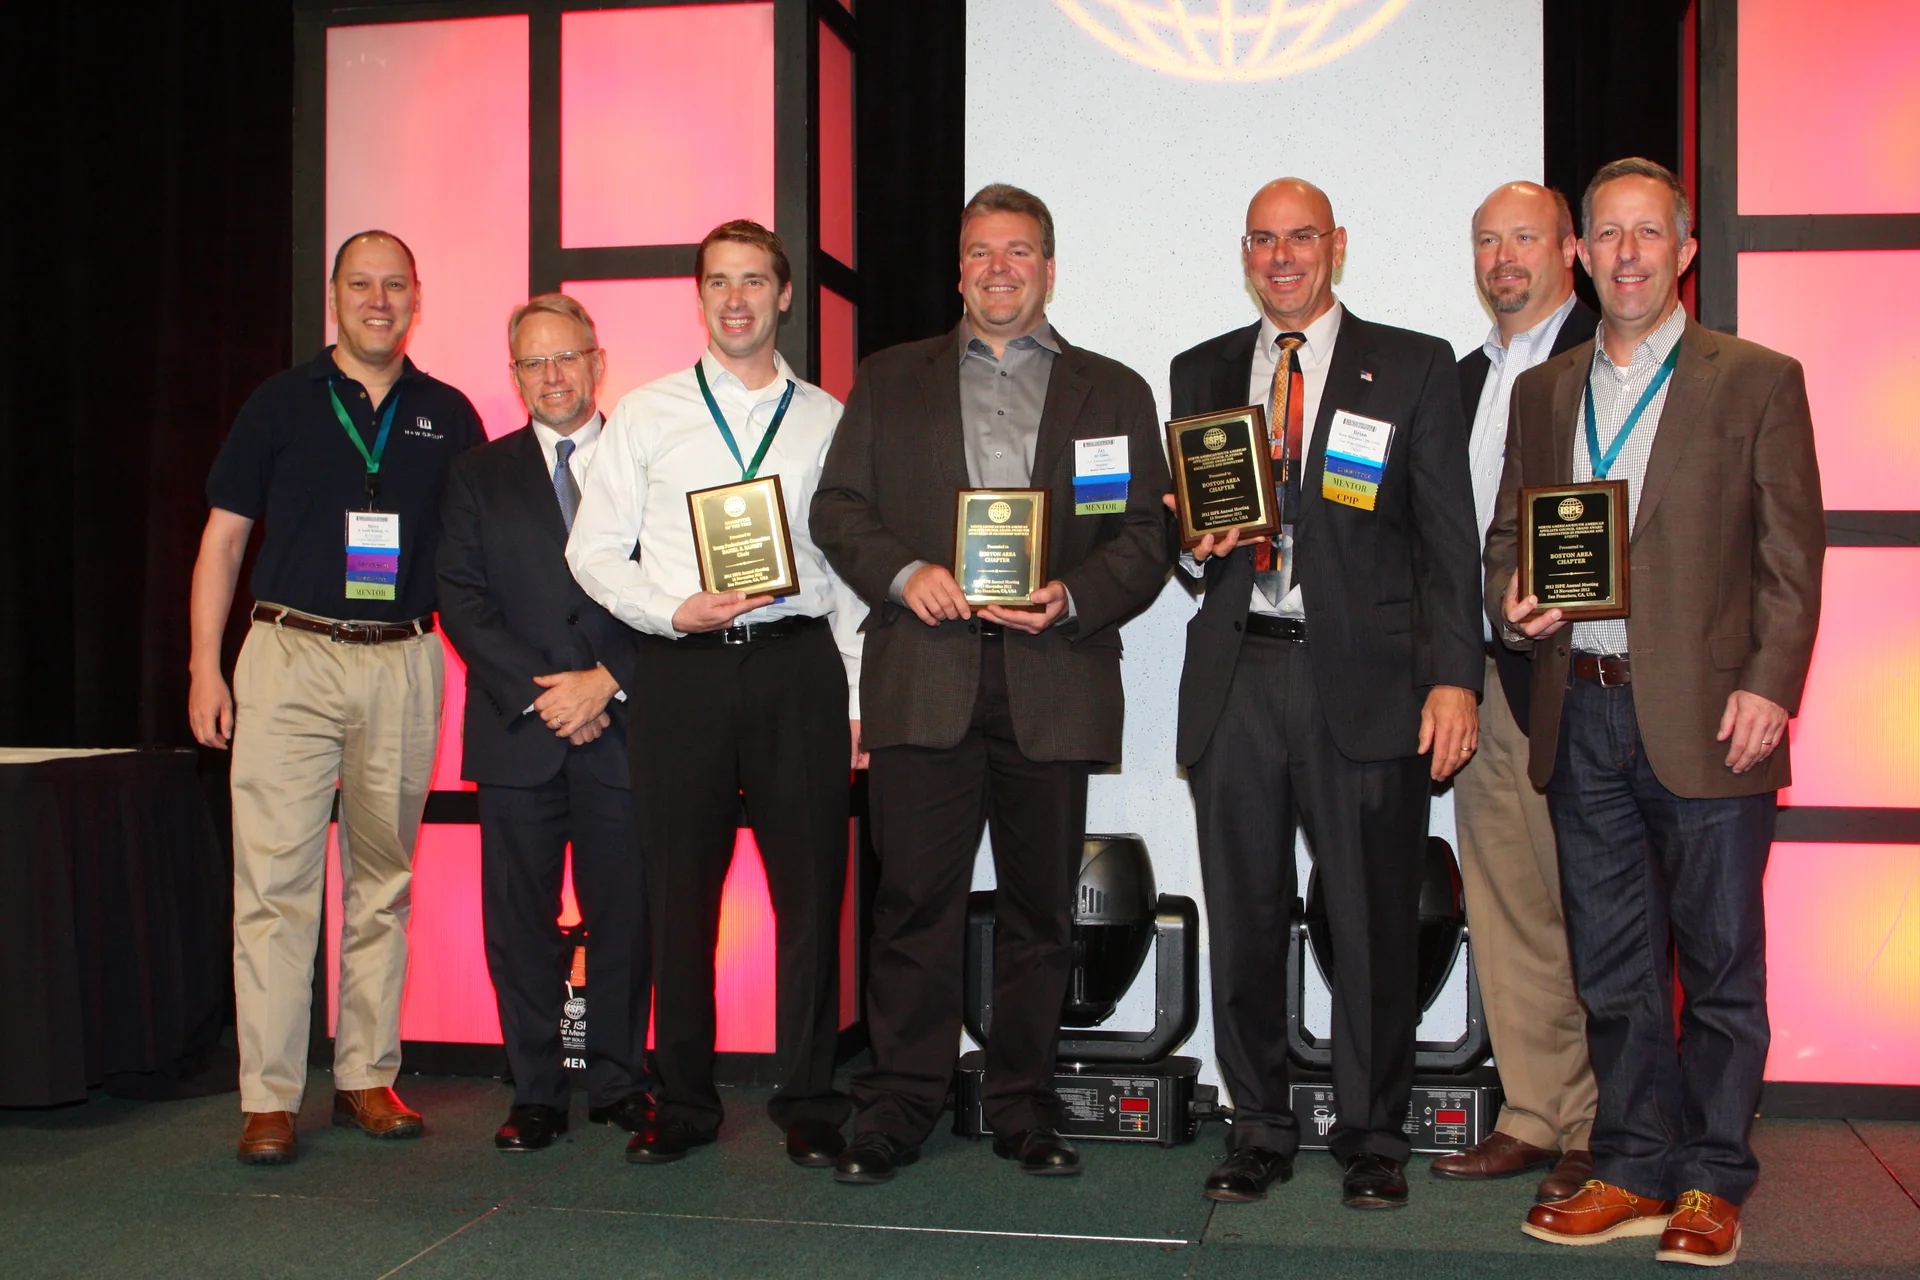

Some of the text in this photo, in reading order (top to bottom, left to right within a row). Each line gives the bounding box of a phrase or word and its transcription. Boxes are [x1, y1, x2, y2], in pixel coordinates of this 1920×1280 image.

[1205, 435, 1224, 445] ISPE
[1202, 480, 1225, 488] BOSTON
[1333, 478, 1367, 492] MENTOR
[1209, 484, 1235, 493] CHAPTER
[1337, 493, 1359, 504] CPIP
[1560, 506, 1581, 514] ISPE
[1550, 552, 1576, 560] BOSTON
[356, 589, 386, 597] MENTOR
